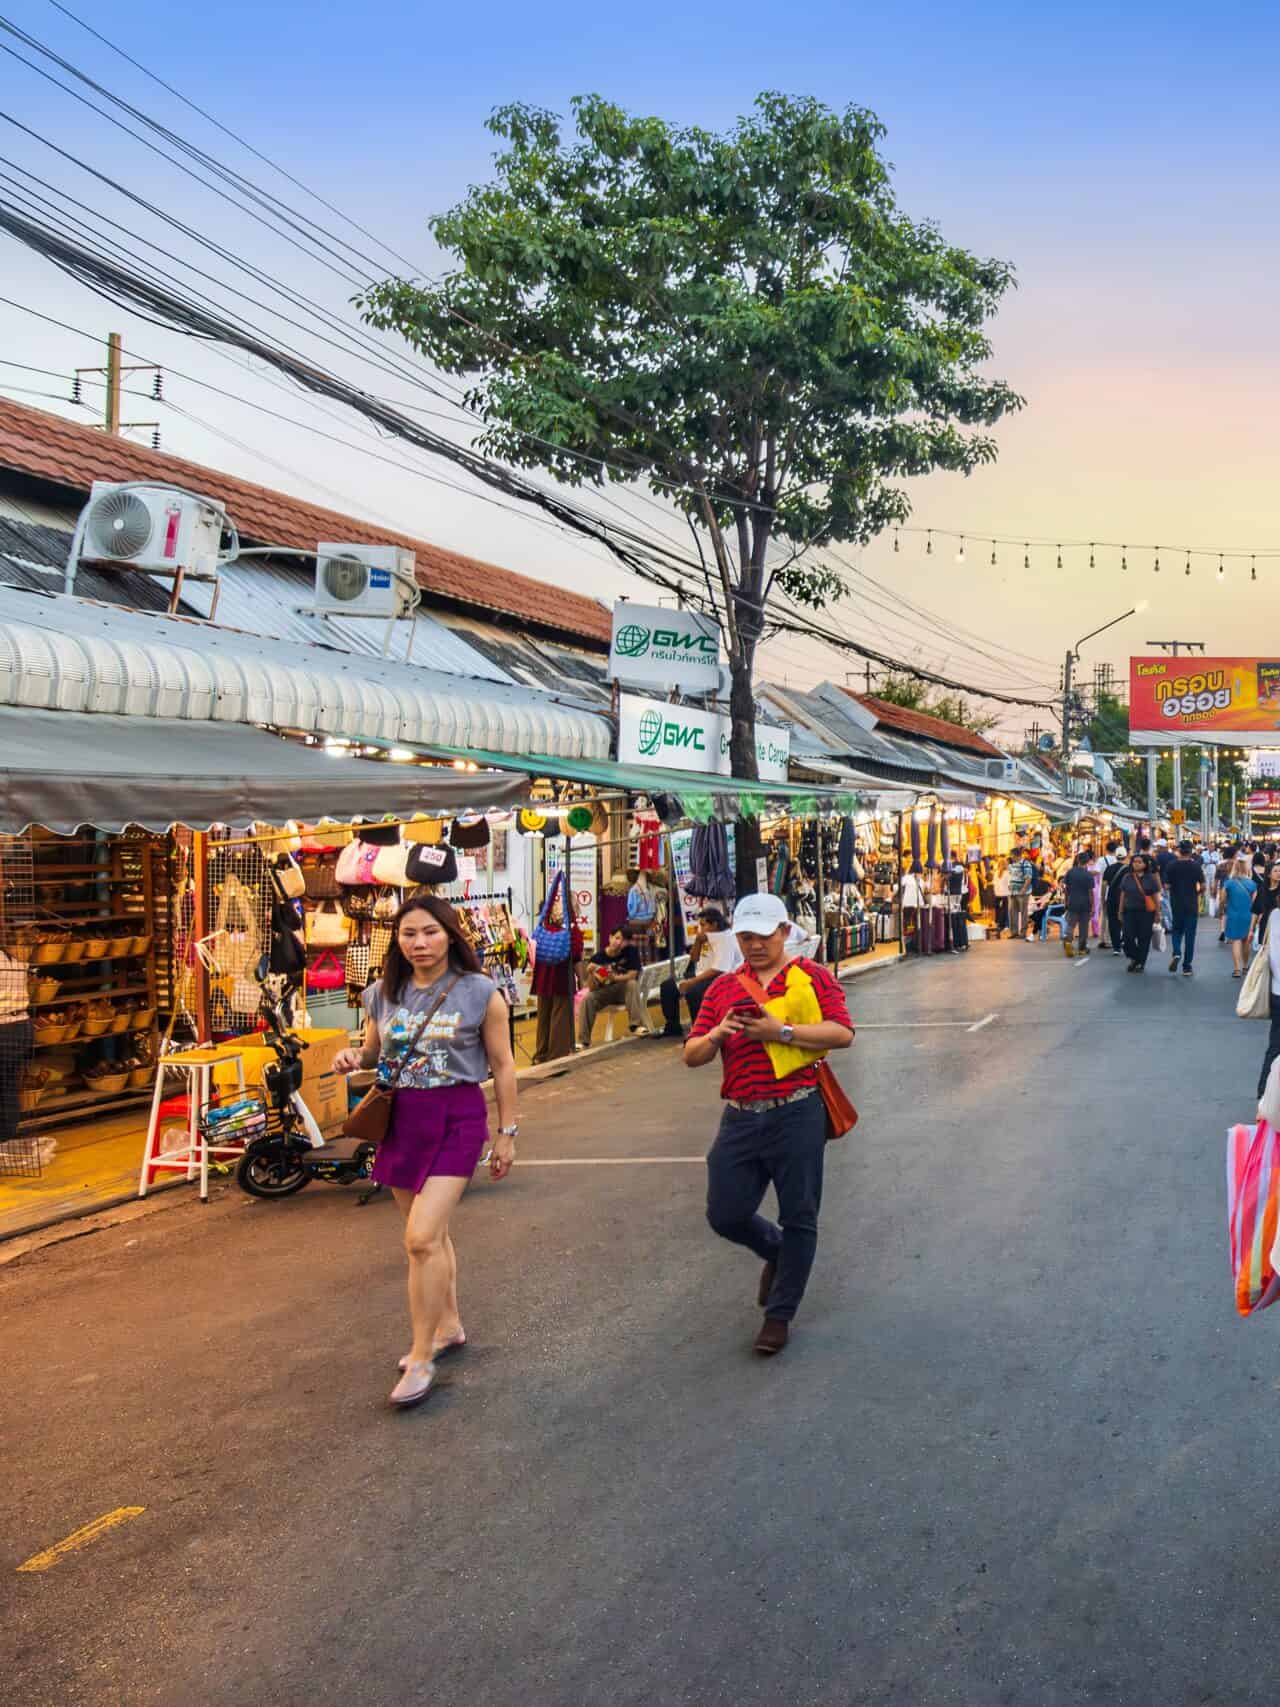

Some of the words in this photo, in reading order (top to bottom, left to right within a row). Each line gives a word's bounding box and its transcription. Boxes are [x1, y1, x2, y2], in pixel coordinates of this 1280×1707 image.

[653, 629, 718, 653] GWC
[1155, 671, 1224, 701] กรอบ
[1161, 688, 1231, 717] อร่อย
[663, 722, 706, 751] GWC
